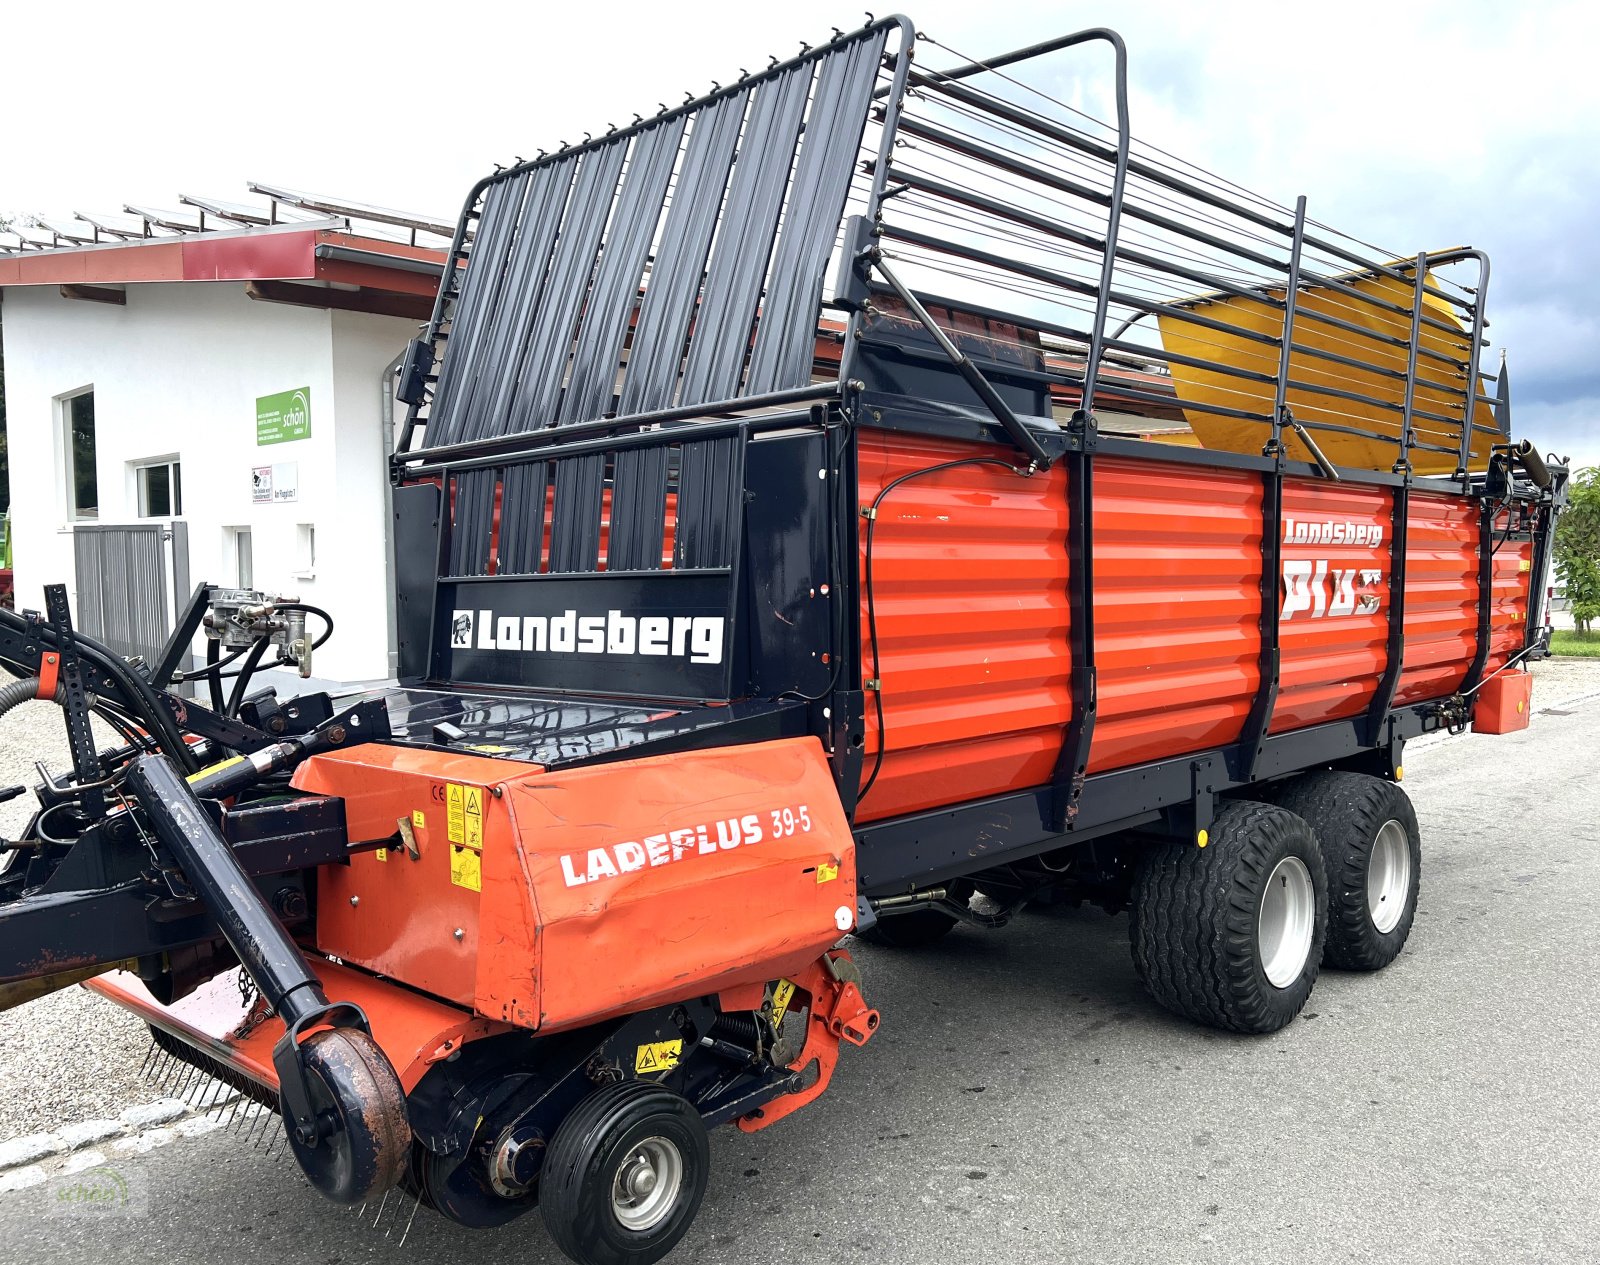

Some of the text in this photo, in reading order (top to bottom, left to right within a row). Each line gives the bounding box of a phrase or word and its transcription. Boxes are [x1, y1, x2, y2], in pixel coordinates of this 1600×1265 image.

[283, 407, 304, 427] schön
[1283, 518, 1383, 548] Landsberg
[477, 609, 725, 664] Landsberg
[559, 805, 812, 887] LADEPLUS 39-5
